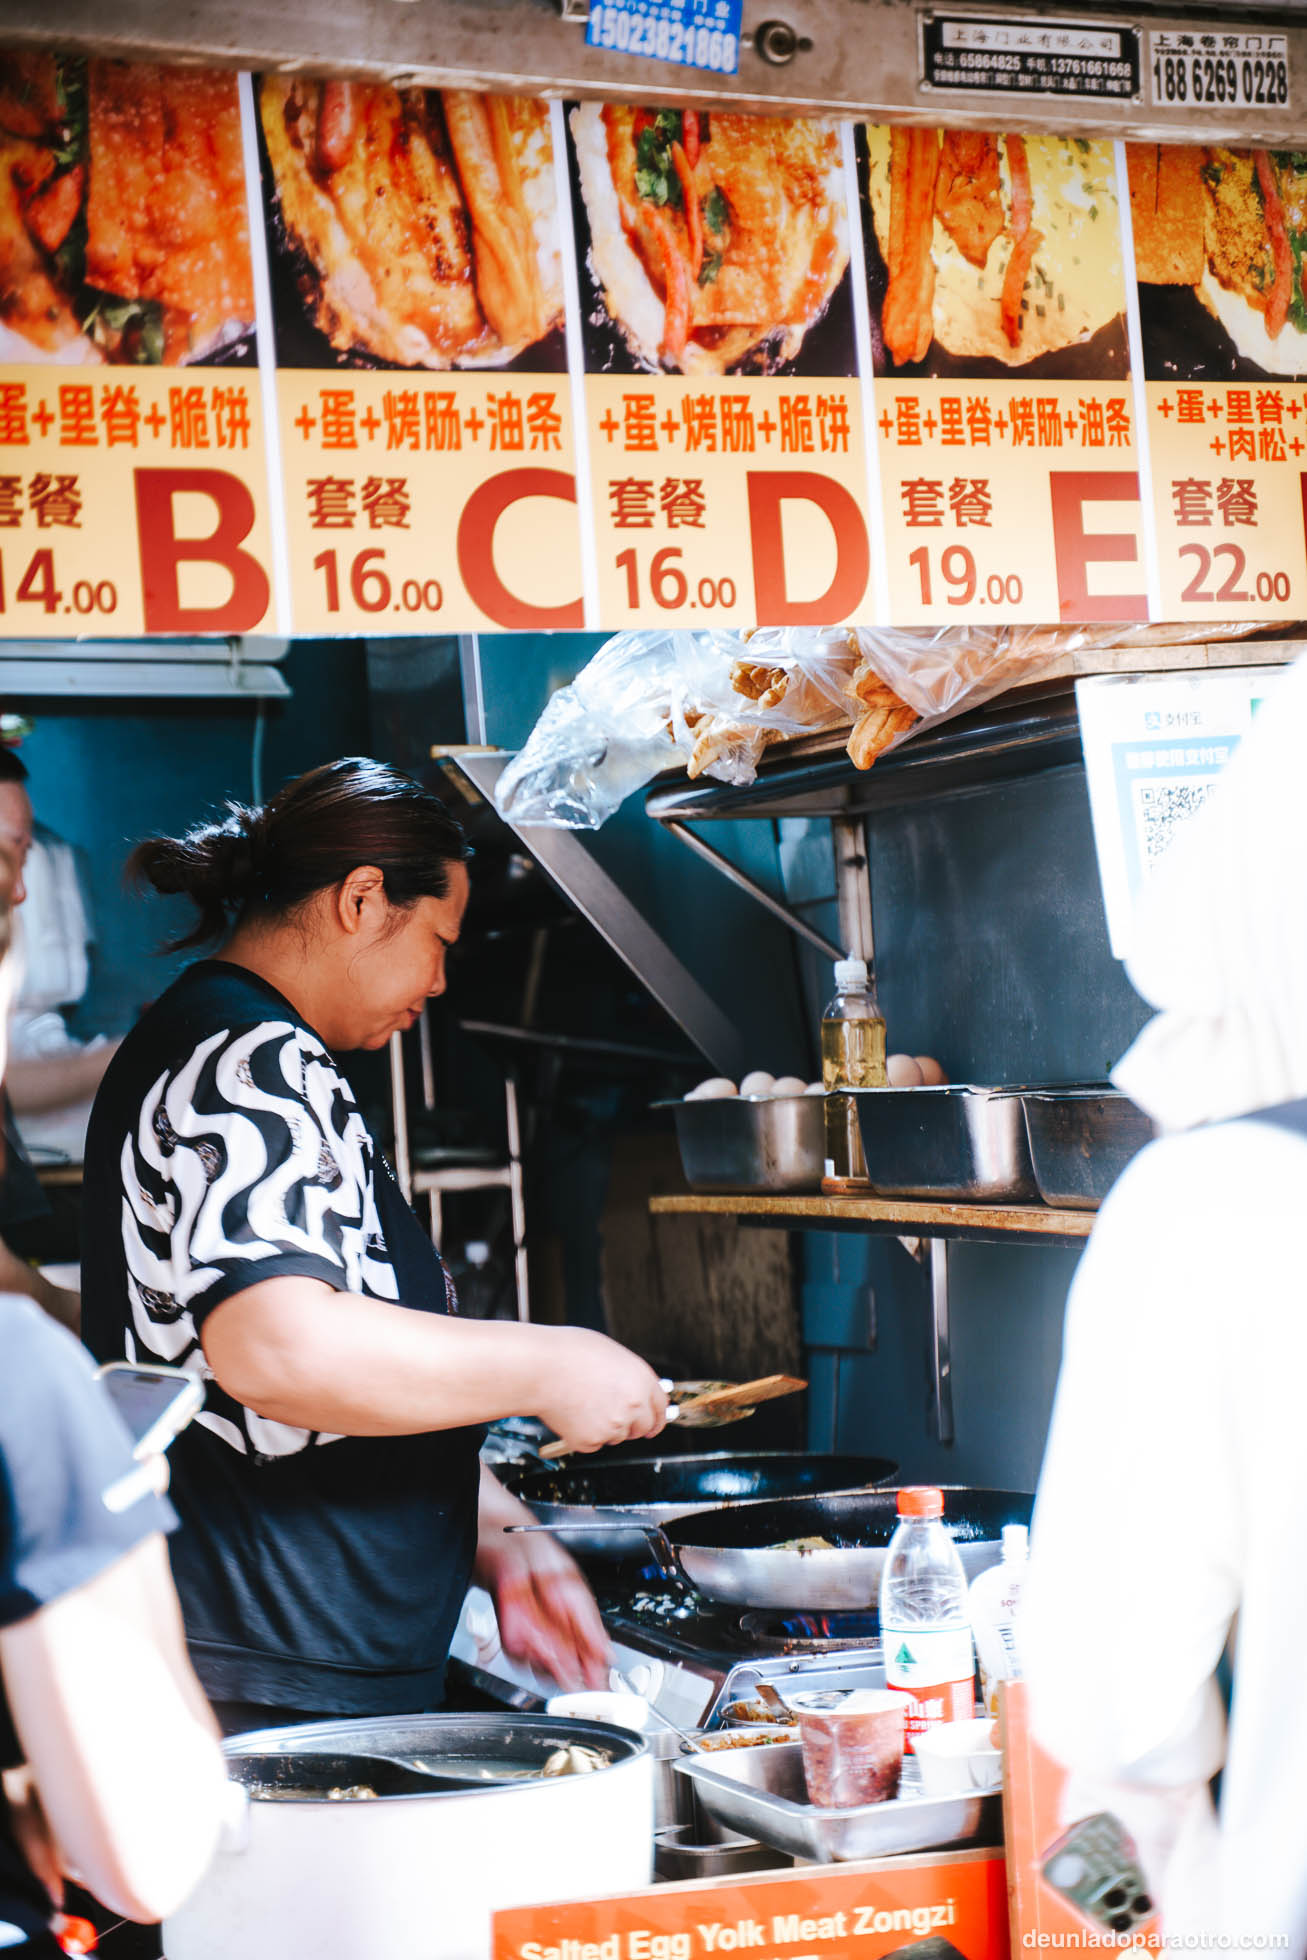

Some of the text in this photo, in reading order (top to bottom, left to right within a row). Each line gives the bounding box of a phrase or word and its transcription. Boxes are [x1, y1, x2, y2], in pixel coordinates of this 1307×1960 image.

[1153, 57, 1187, 102] 188
[1193, 58, 1237, 103] 6269
[1243, 60, 1288, 104] 0228
[295, 389, 563, 452] +蛋+烤肠+油条
[599, 393, 850, 453] +蛋+烤肠+脆饼
[879, 395, 1132, 448] +蛋+里脊+烤肠+油条
[1157, 389, 1307, 425] +蛋+里脊+
[306, 475, 412, 529] 套餐
[609, 476, 707, 529] 套餐
[901, 477, 994, 528] 套餐
[1172, 477, 1259, 527] 套餐
[134, 467, 271, 633] B
[457, 467, 586, 630] C
[746, 470, 871, 627] D
[909, 545, 1024, 605] 19.00
[1049, 470, 1151, 623] E
[1178, 543, 1291, 602] 22.00
[313, 548, 443, 614] 16.00
[615, 546, 737, 610] 16.00
[629, 1930, 691, 1960] Egg
[698, 1920, 766, 1952] Yolk
[773, 1910, 847, 1945] Meat
[853, 1898, 956, 1936] Zongzi
